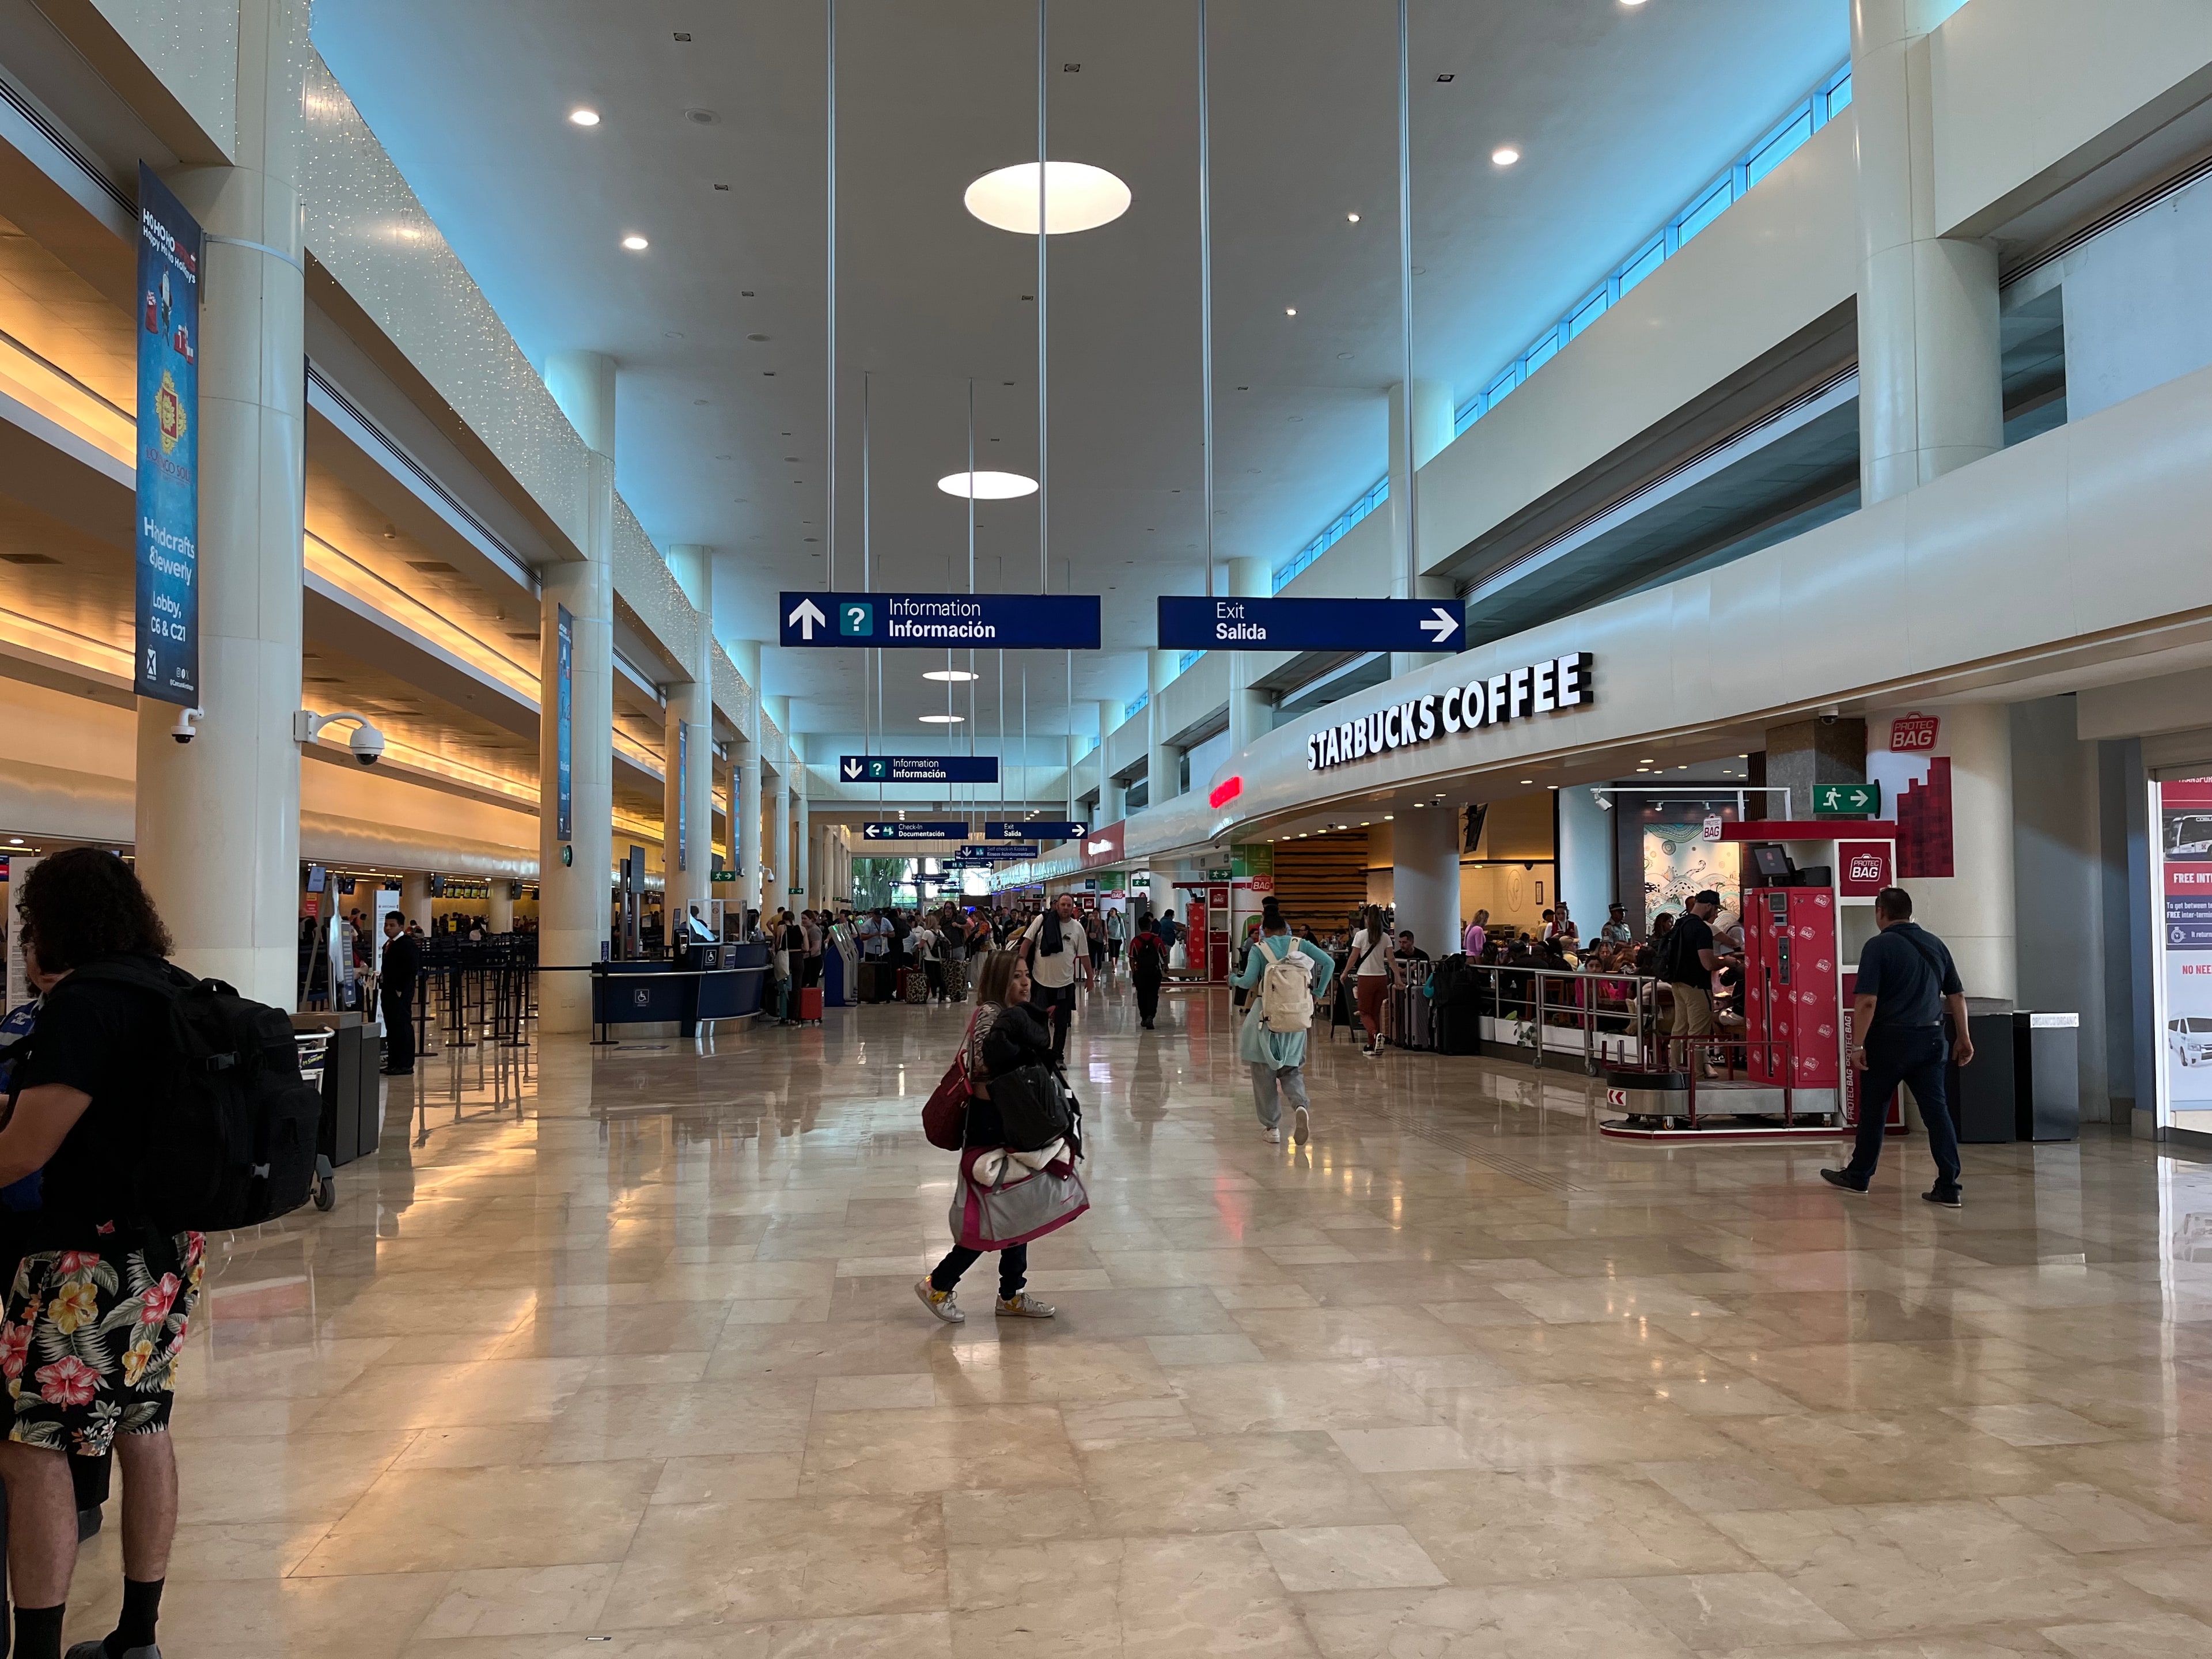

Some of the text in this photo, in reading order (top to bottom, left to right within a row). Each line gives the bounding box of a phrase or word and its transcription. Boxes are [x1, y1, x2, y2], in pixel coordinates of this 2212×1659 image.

[153, 590, 182, 619] Lobby,
[889, 599, 980, 616] Information
[1217, 602, 1245, 619] Exit
[151, 616, 186, 642] C6 & C21
[889, 620, 995, 638] Información
[1216, 623, 1266, 640] Salida
[1307, 652, 1585, 771] STARBUCKS COFFEE
[1894, 720, 1934, 731] PROTEC
[1892, 730, 1932, 748] BAG
[893, 758, 939, 768] Information
[893, 768, 946, 778] Información
[1704, 826, 1719, 838] BAG
[1852, 867, 1878, 878] BAG
[2173, 873, 2212, 883] FREE INT
[1253, 882, 1270, 890] BAG
[1815, 897, 1826, 906] BAG
[2174, 902, 2184, 911] get
[1801, 930, 1812, 938] BAG
[1817, 962, 1828, 971] BAG
[2182, 965, 2212, 974] NO NEE
[1819, 1028, 1830, 1036] BAG
[1805, 1060, 1815, 1069] BAG
